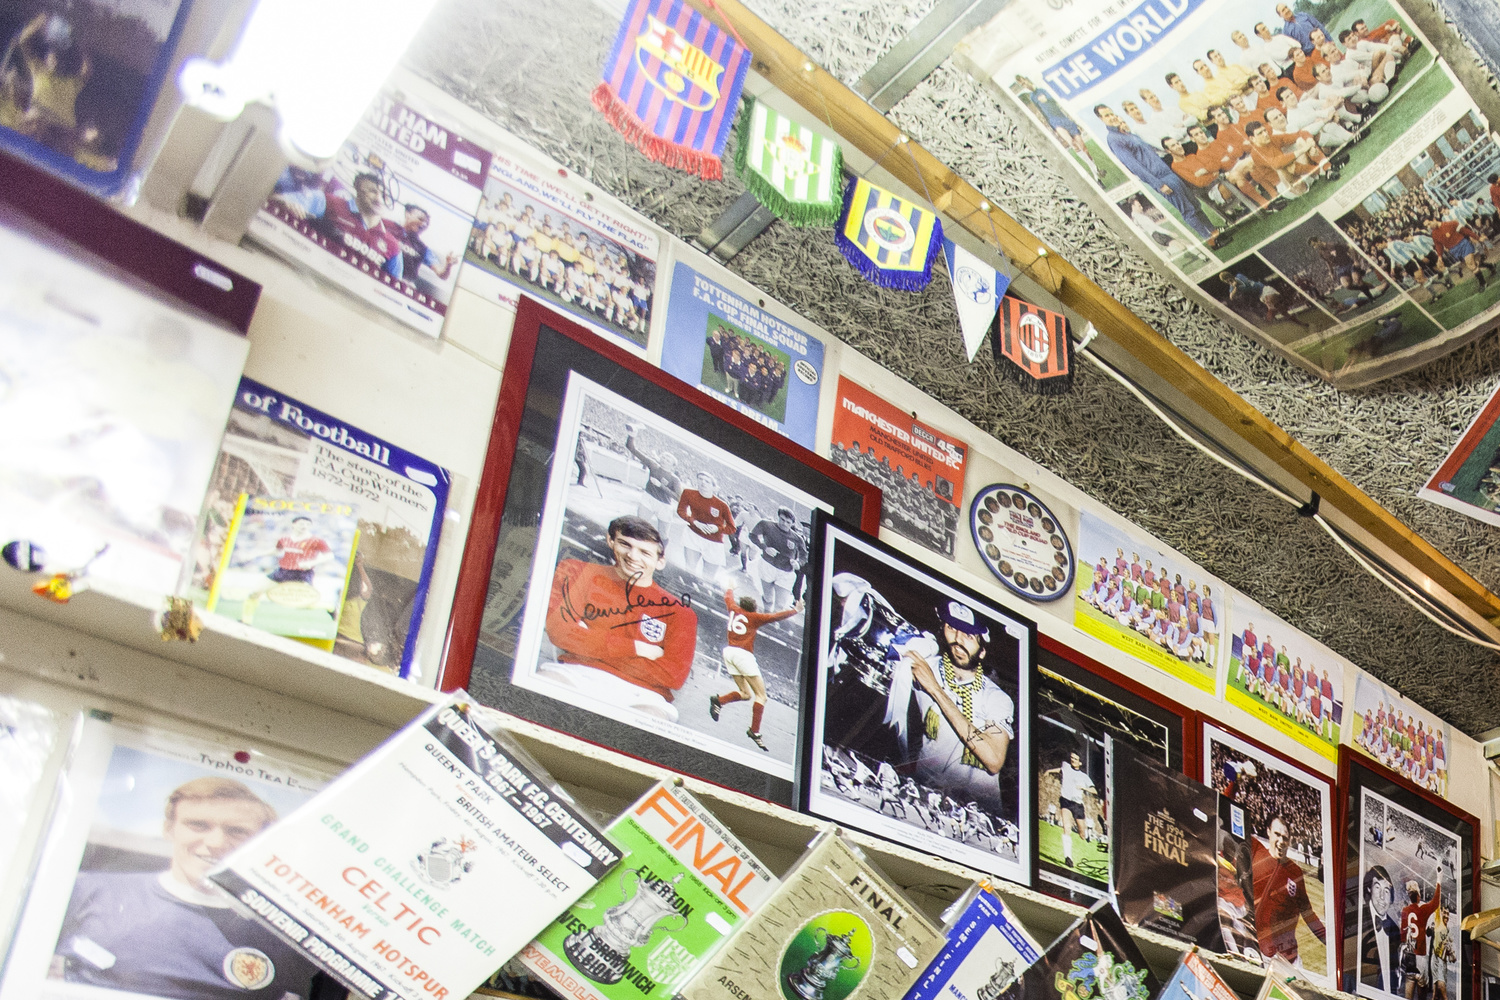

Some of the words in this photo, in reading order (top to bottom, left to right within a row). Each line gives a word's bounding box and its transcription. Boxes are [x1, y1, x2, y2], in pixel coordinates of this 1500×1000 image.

[398, 109, 448, 150] HAM
[694, 274, 762, 321] TOTTENHAM
[762, 310, 808, 347] HOTSPUR
[772, 327, 807, 357] SQUAD
[243, 389, 278, 417] of
[280, 402, 391, 467] Football
[842, 397, 910, 443] MANCHESTER
[910, 431, 945, 463] UNITED
[726, 613, 748, 636] 16
[424, 743, 465, 779] QUEEN'S
[466, 780, 494, 805] PARK
[456, 797, 493, 834] BRITISH
[493, 827, 538, 868] AMATEUR
[537, 864, 570, 893] SELECT
[635, 786, 756, 917] FINAL
[1144, 835, 1188, 867] FINAL
[1148, 814, 1169, 831] THE
[1167, 835, 1189, 851] CUP
[264, 855, 371, 939] TOTTENHAM
[320, 813, 370, 854] GRAND
[374, 857, 449, 919] CHALLENGE
[450, 918, 497, 957] MATCH
[341, 866, 442, 946] CELTIC
[636, 864, 695, 917] EVERTON
[850, 876, 904, 931] FINAL
[241, 889, 309, 942] SOUVENIR
[303, 934, 384, 999] PROGRAMME
[1406, 911, 1419, 939] 6
[589, 934, 657, 996] BROMWICH
